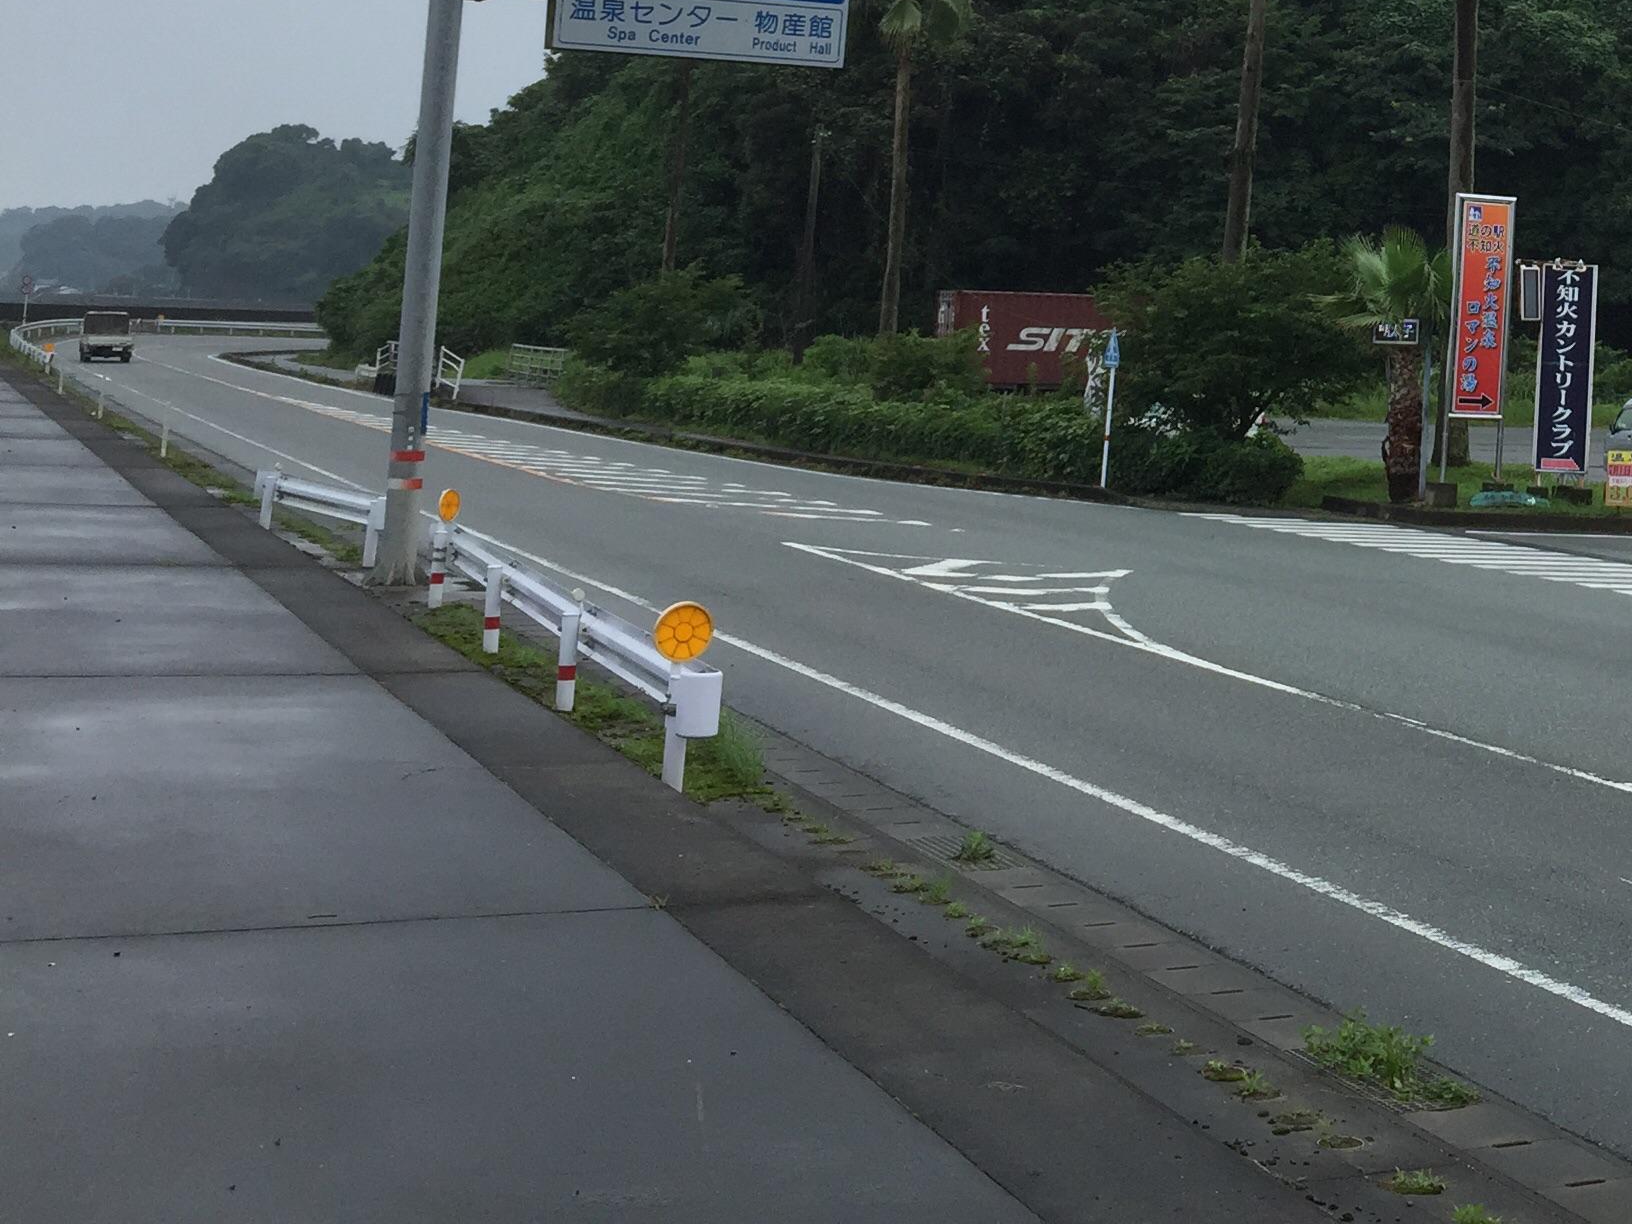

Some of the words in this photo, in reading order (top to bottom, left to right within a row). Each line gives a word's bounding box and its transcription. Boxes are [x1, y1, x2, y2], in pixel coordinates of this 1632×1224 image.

[754, 10, 833, 39] 物産館
[607, 26, 637, 43] Spa
[649, 29, 701, 46] Center
[752, 37, 797, 53] Product
[810, 41, 832, 55] Hall
[1467, 238, 1504, 254] 不知火
[1468, 224, 1505, 240] 道の駅
[1480, 256, 1502, 350] 不知火温泉
[1459, 301, 1480, 394] ロマンの湯
[1550, 269, 1581, 458] 不知火カントリークラブ
